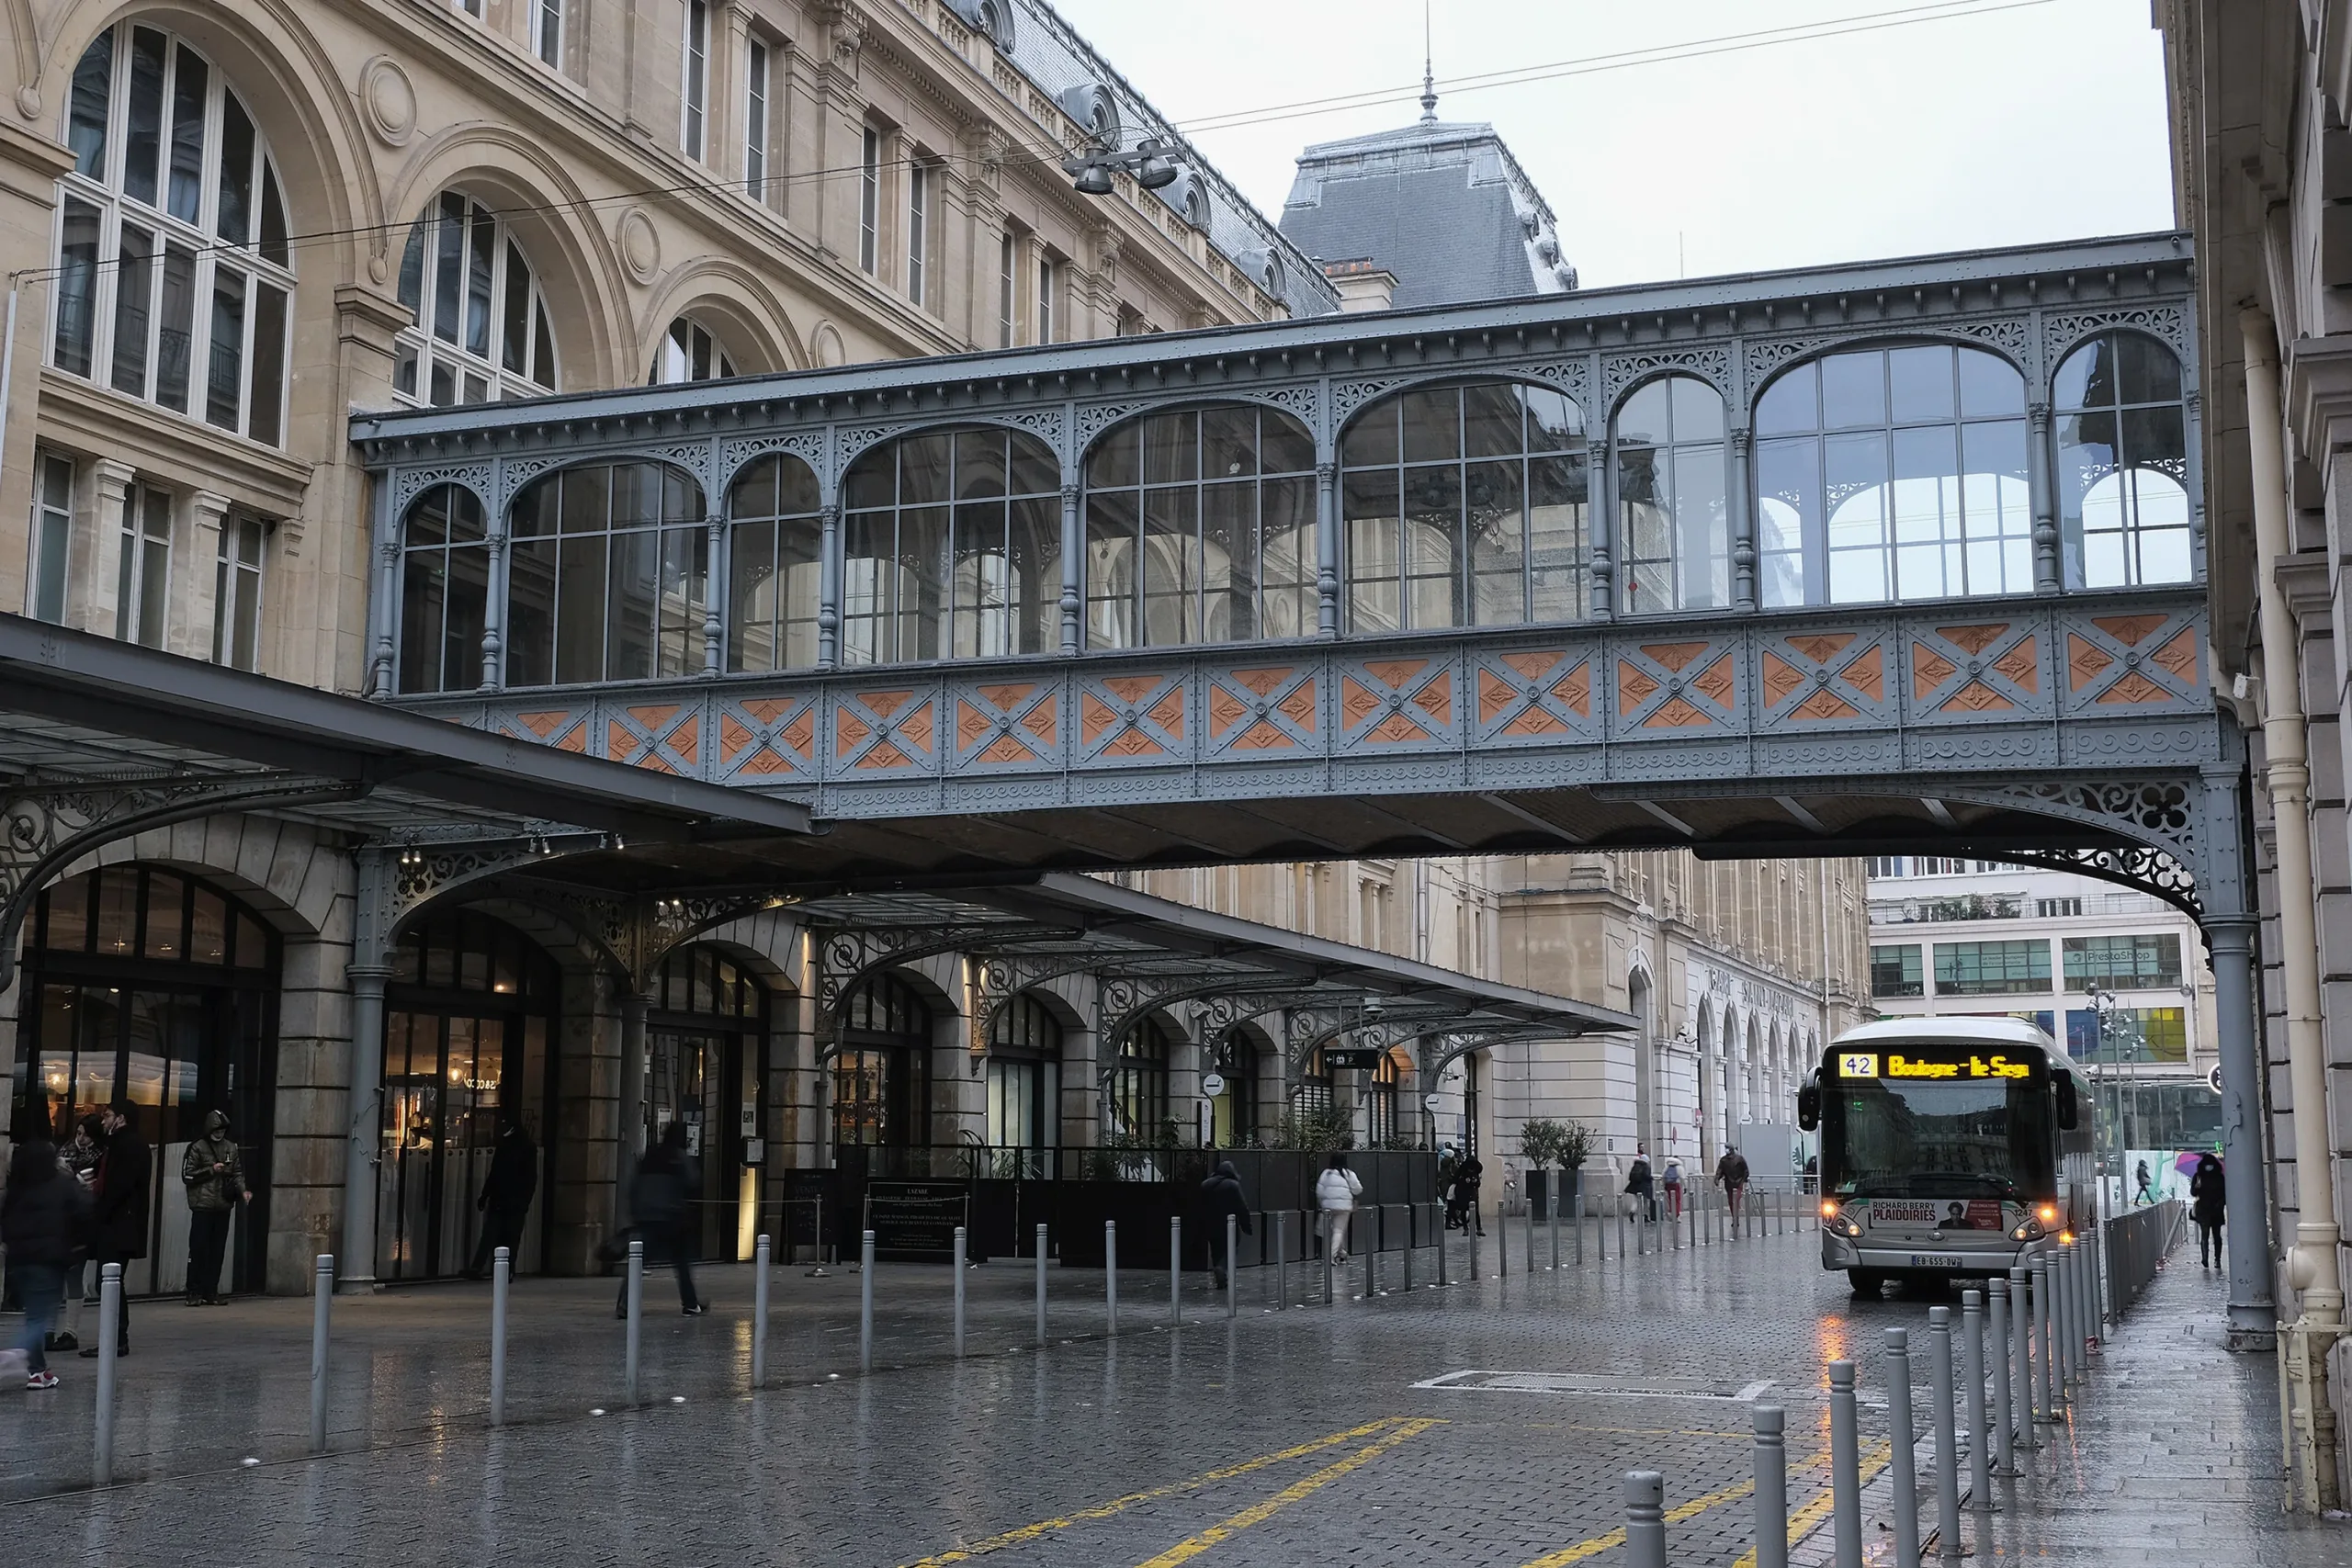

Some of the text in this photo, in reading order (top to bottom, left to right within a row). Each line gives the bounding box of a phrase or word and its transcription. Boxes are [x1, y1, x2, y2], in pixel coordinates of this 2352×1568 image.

[2087, 951, 2151, 962] PrestaShop
[1846, 1056, 1871, 1075] 42
[1873, 1201, 1909, 1210] RICHARD
[1873, 1209, 1936, 1221] PLAIDOIRIES
[2014, 1209, 2032, 1217] 1247
